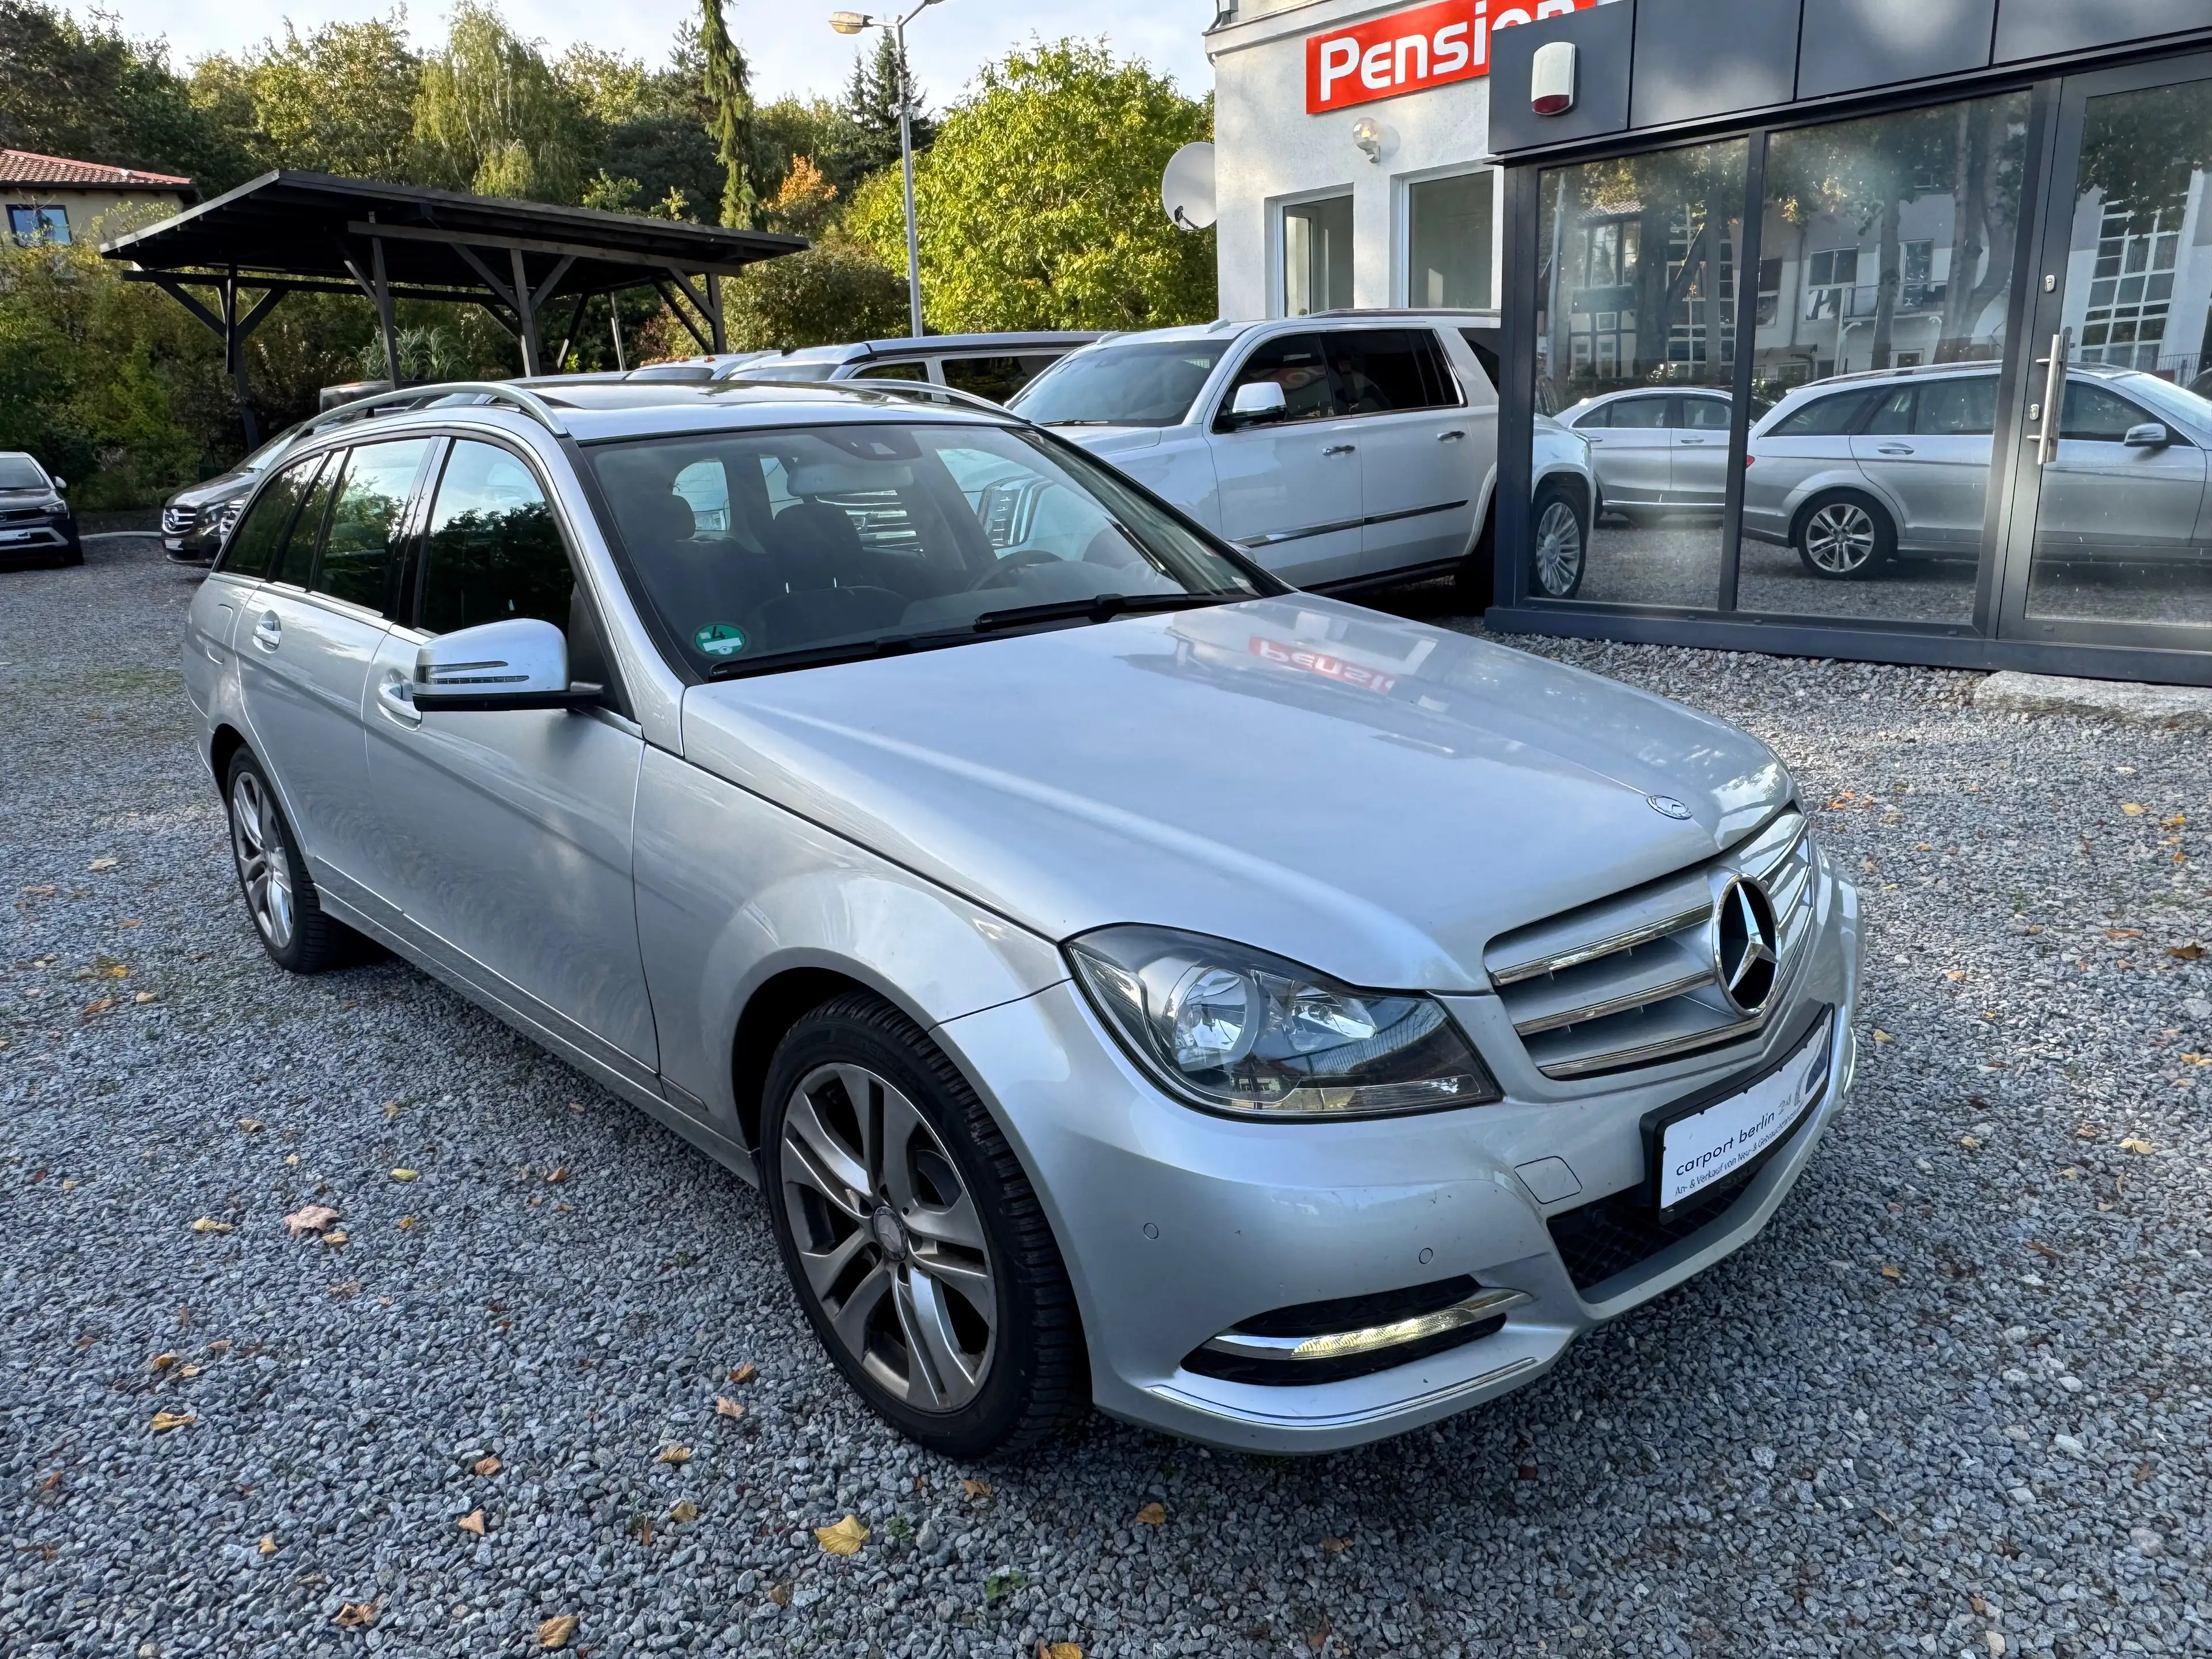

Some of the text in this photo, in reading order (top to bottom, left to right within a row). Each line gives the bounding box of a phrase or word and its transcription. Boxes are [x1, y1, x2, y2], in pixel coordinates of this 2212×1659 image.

[711, 626, 726, 639] 4
[1676, 1137, 1734, 1176] carport
[1739, 1112, 1775, 1143] berlin
[1690, 1179, 1696, 1188] &
